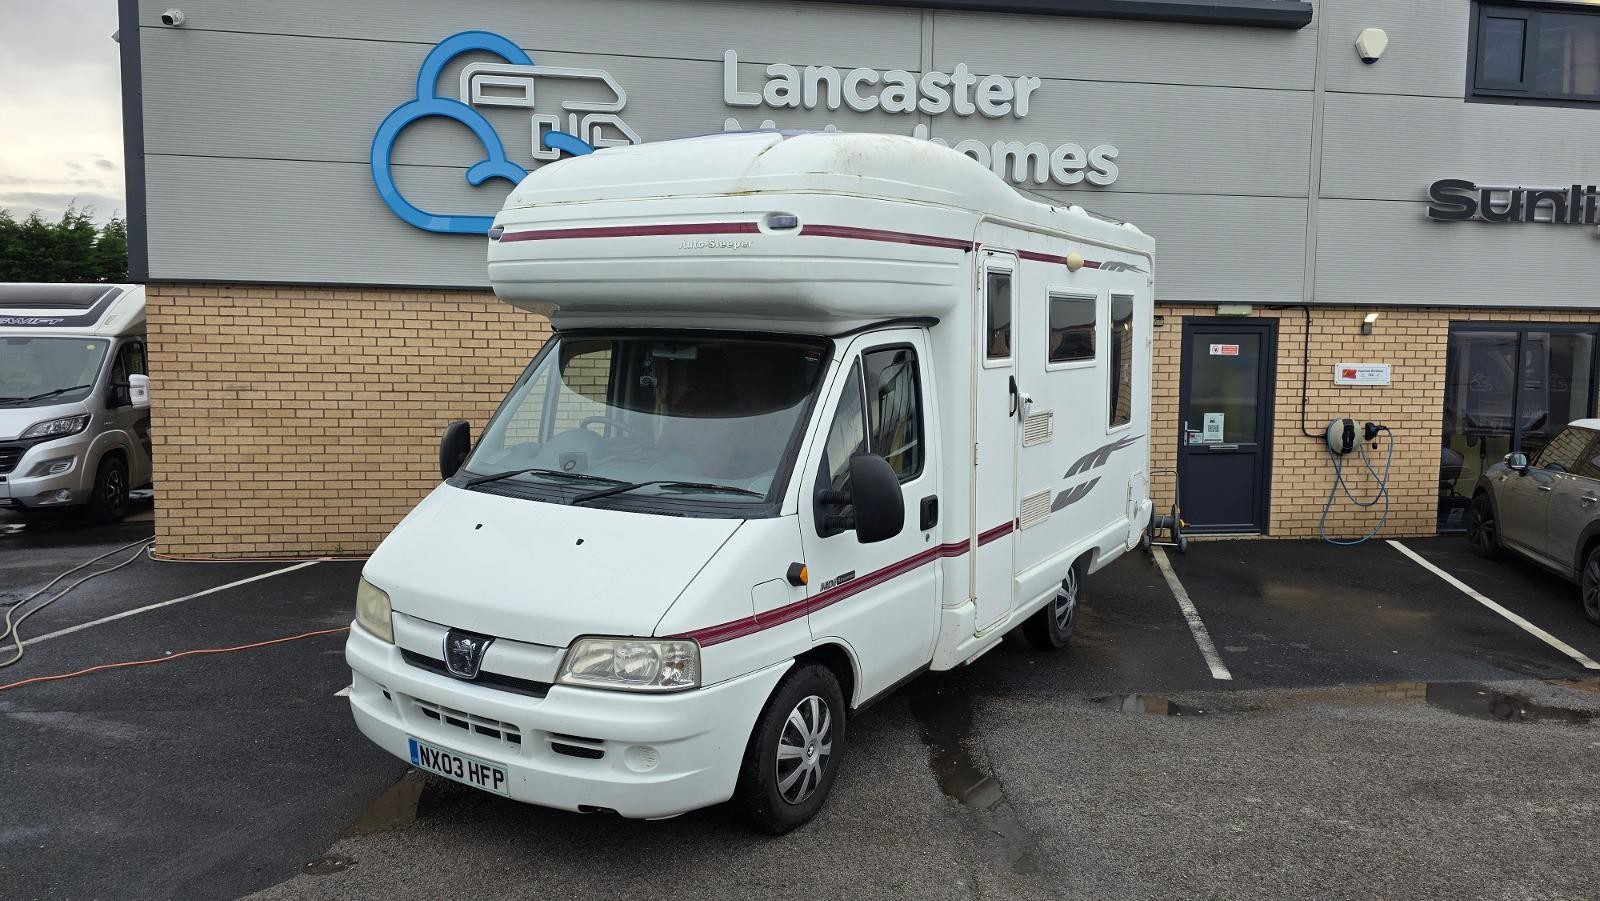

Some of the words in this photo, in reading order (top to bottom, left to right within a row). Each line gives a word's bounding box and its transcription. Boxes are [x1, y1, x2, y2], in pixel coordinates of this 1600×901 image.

[723, 49, 1041, 119] Lancaster
[1427, 178, 1600, 226] Sunli
[678, 239, 754, 251] Auto-Sleeper
[419, 744, 464, 778] NX03
[467, 761, 505, 790] HFP
